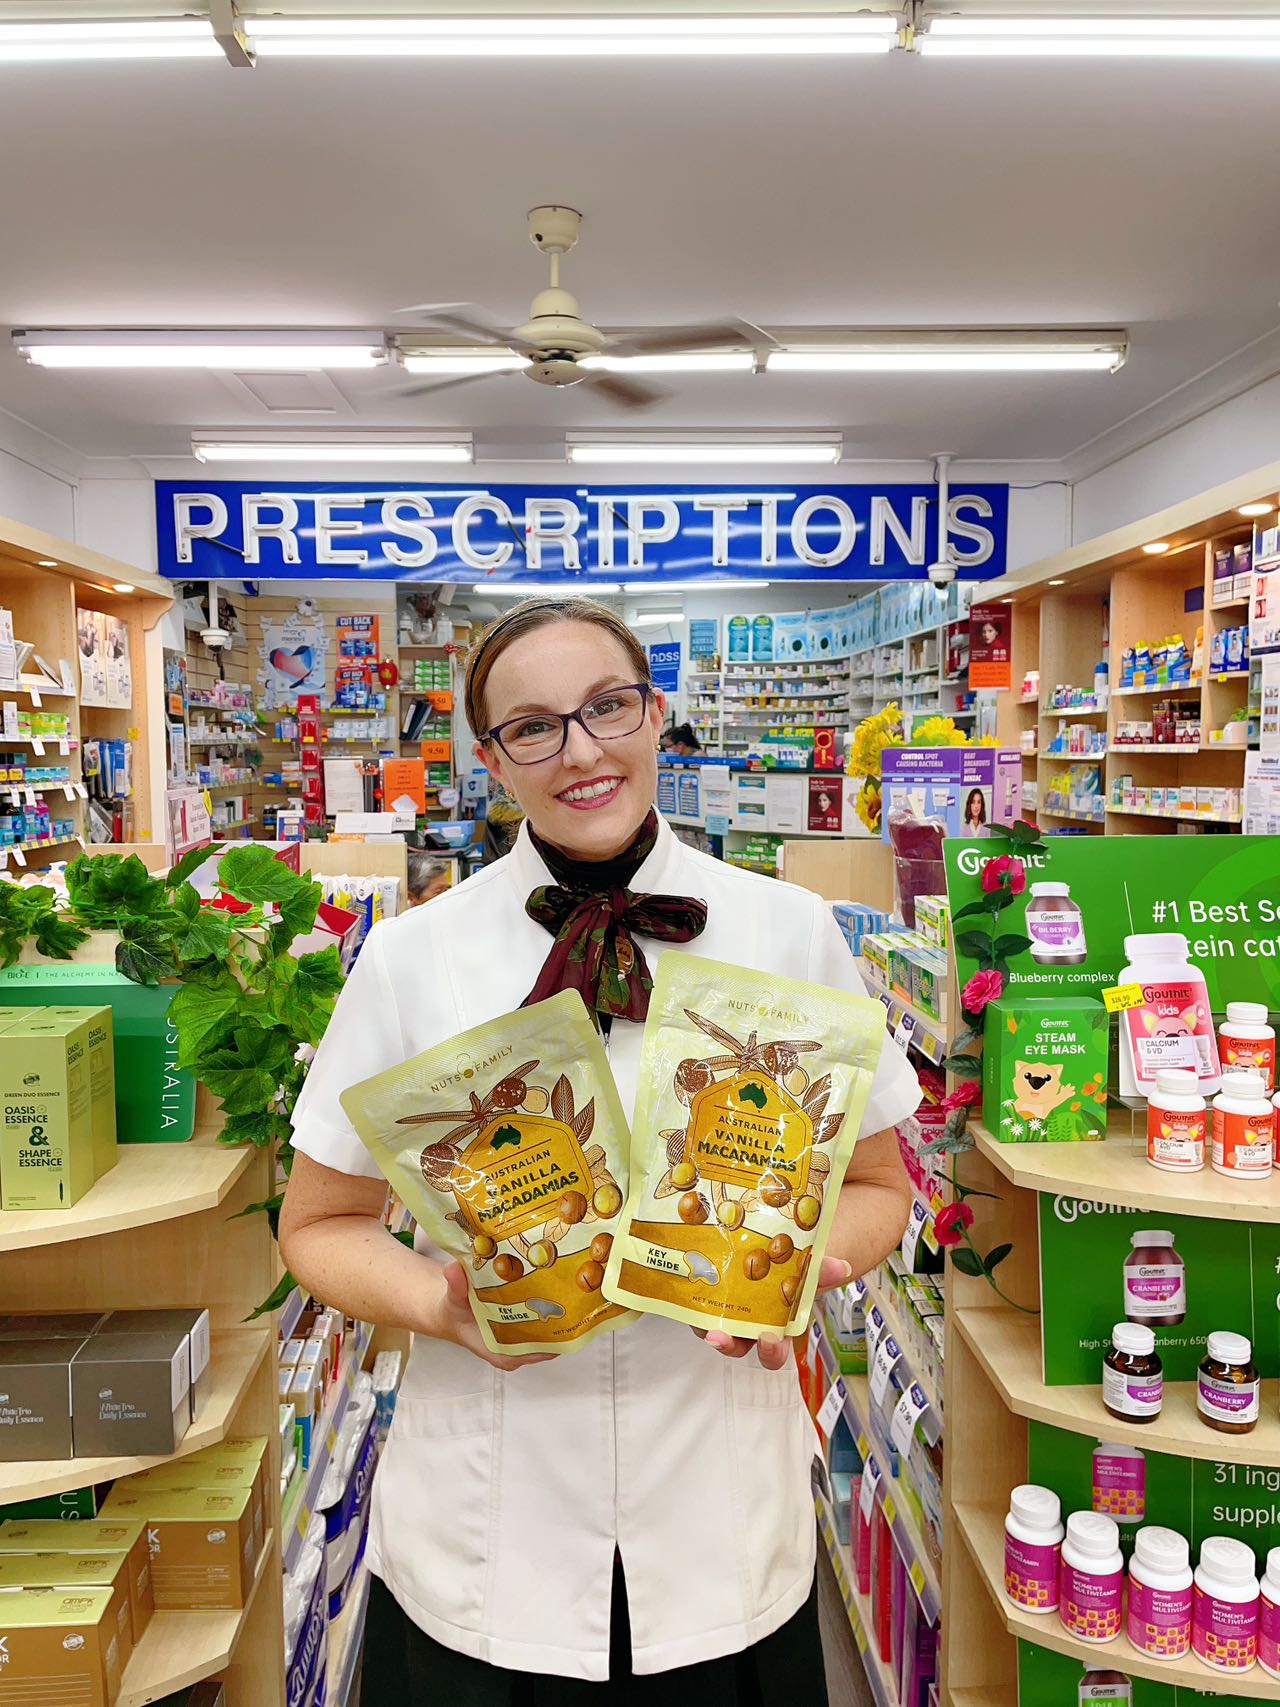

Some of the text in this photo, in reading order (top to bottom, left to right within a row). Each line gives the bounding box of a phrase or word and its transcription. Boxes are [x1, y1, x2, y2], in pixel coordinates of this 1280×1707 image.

[173, 493, 995, 568] PRESCRIPTIONS
[1152, 900, 1179, 923] #1
[1189, 900, 1251, 923] Best
[1009, 971, 1115, 984] Blueberry complex
[728, 1000, 810, 1024] NUTS FAMILY
[1157, 1004, 1179, 1016] kids
[1035, 1033, 1076, 1043] STEAM
[1025, 1044, 1086, 1055] EYE MASK
[431, 1045, 513, 1093] NUTS FAMILY
[5, 1106, 35, 1114] OASIS
[5, 1115, 48, 1123] ESSENCE
[718, 1115, 782, 1136] AUSTRALIAN
[29, 1126, 49, 1146] &
[715, 1129, 785, 1153] VANILLA
[19, 1149, 51, 1158] SHAPE
[697, 1140, 797, 1172] MACADAMIAS
[20, 1158, 62, 1167] ESSENCE
[485, 1150, 551, 1183] AUSTRALIAN
[478, 1171, 579, 1222] MACADAMIAS
[648, 1248, 667, 1259] KEY
[646, 1256, 680, 1271] INSIDE
[692, 1296, 706, 1304] NET
[708, 1300, 734, 1310] WEIGHT
[501, 1313, 530, 1321] INSIDE
[1080, 1339, 1100, 1350] High
[1204, 1390, 1246, 1405] CRANBERRY
[1214, 1464, 1236, 1484] 31
[1073, 1580, 1103, 1592] WOMEN'S
[1073, 1585, 1117, 1596] MULTIVITAMIN
[1152, 1602, 1191, 1613] MULTIVITAMIN
[1212, 1609, 1244, 1619] WOMEN'S
[1212, 1615, 1256, 1625] MULTIVITAMIN
